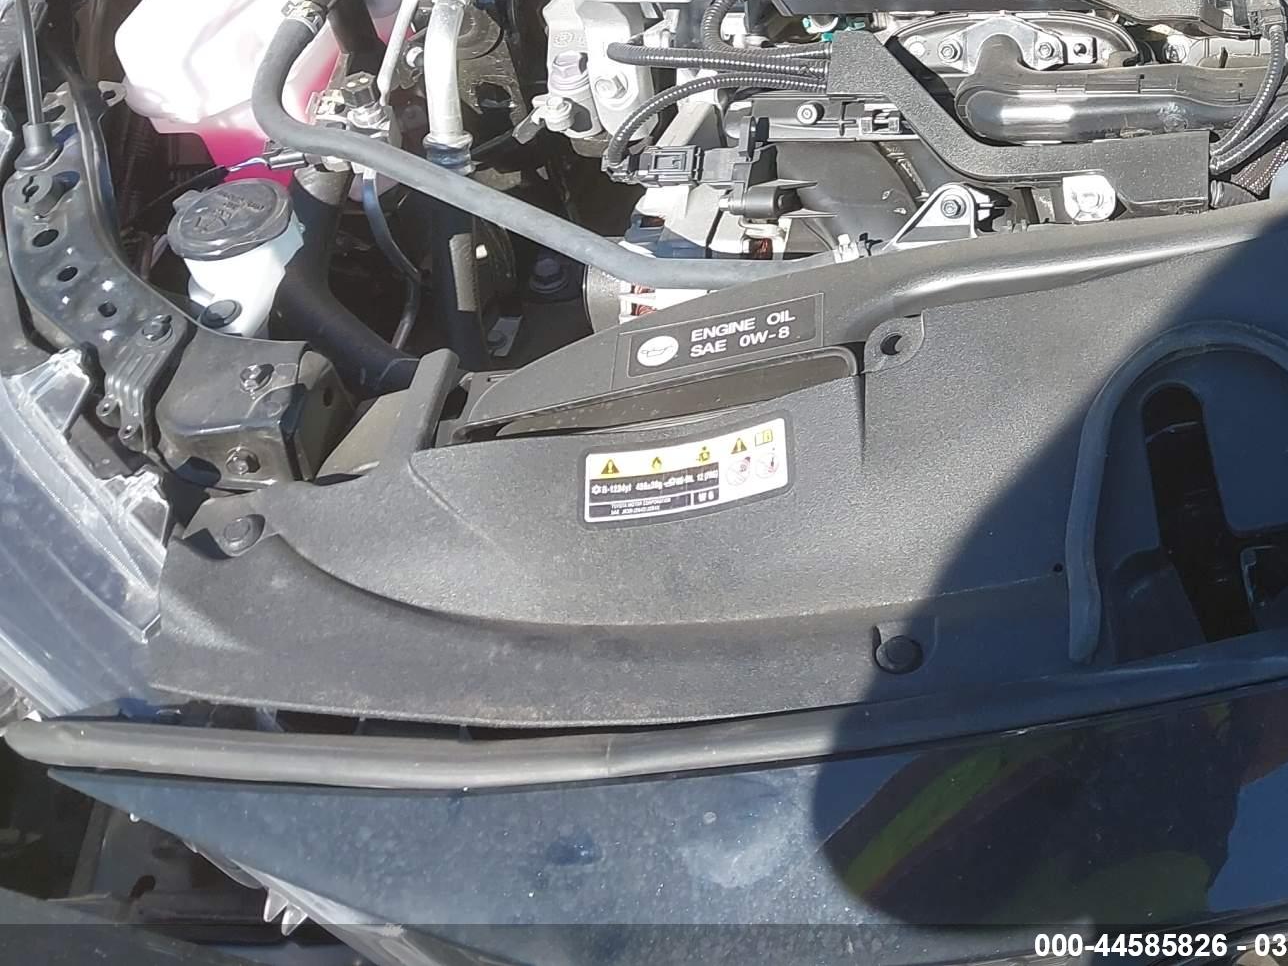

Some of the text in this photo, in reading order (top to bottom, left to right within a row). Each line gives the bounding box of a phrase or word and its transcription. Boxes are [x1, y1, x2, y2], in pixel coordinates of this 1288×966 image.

[690, 309, 796, 342] ENGINE OIL
[690, 326, 790, 358] SAE 0W-8
